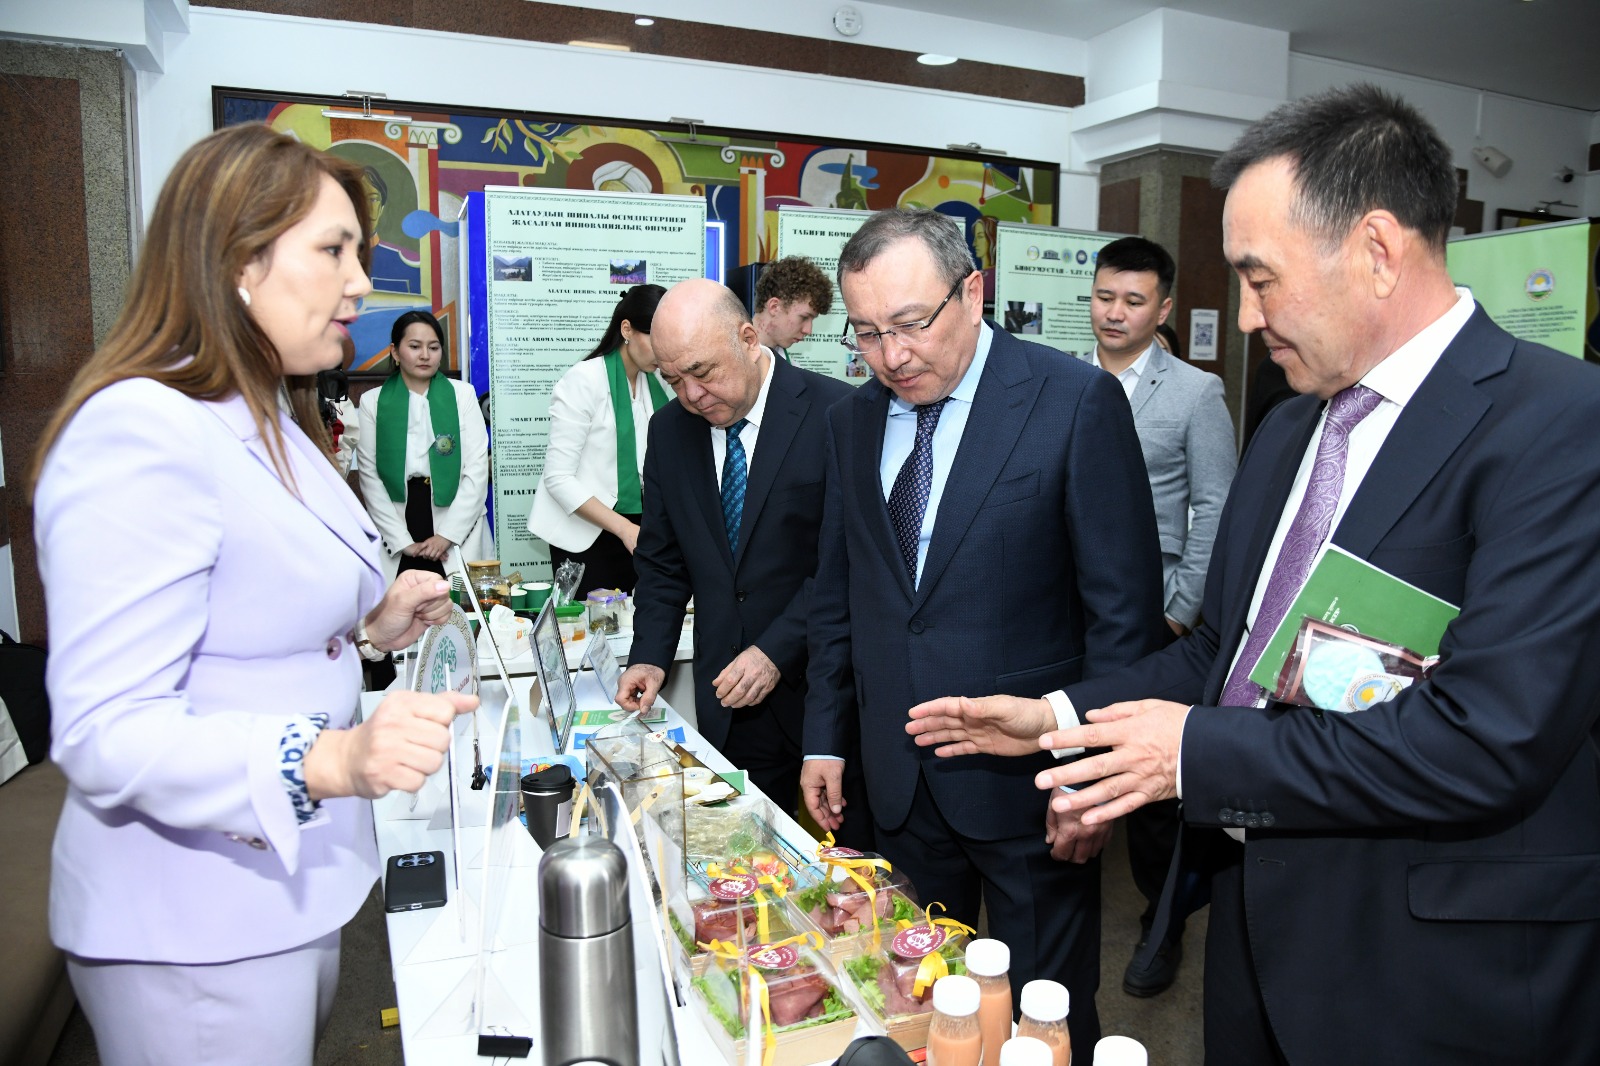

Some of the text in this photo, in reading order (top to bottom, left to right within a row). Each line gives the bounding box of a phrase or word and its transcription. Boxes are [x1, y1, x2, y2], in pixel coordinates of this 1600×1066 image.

[509, 209, 686, 223] АЛАТАУДЫҢ ШИПАЛЫ ӨСІМДІКТЕРІНЕН
[511, 219, 562, 227] ЖАСАЛҒАН
[565, 221, 642, 231] ИННОВАЦИЯЛЫҚ
[792, 228, 826, 236] ТАБИҒИ
